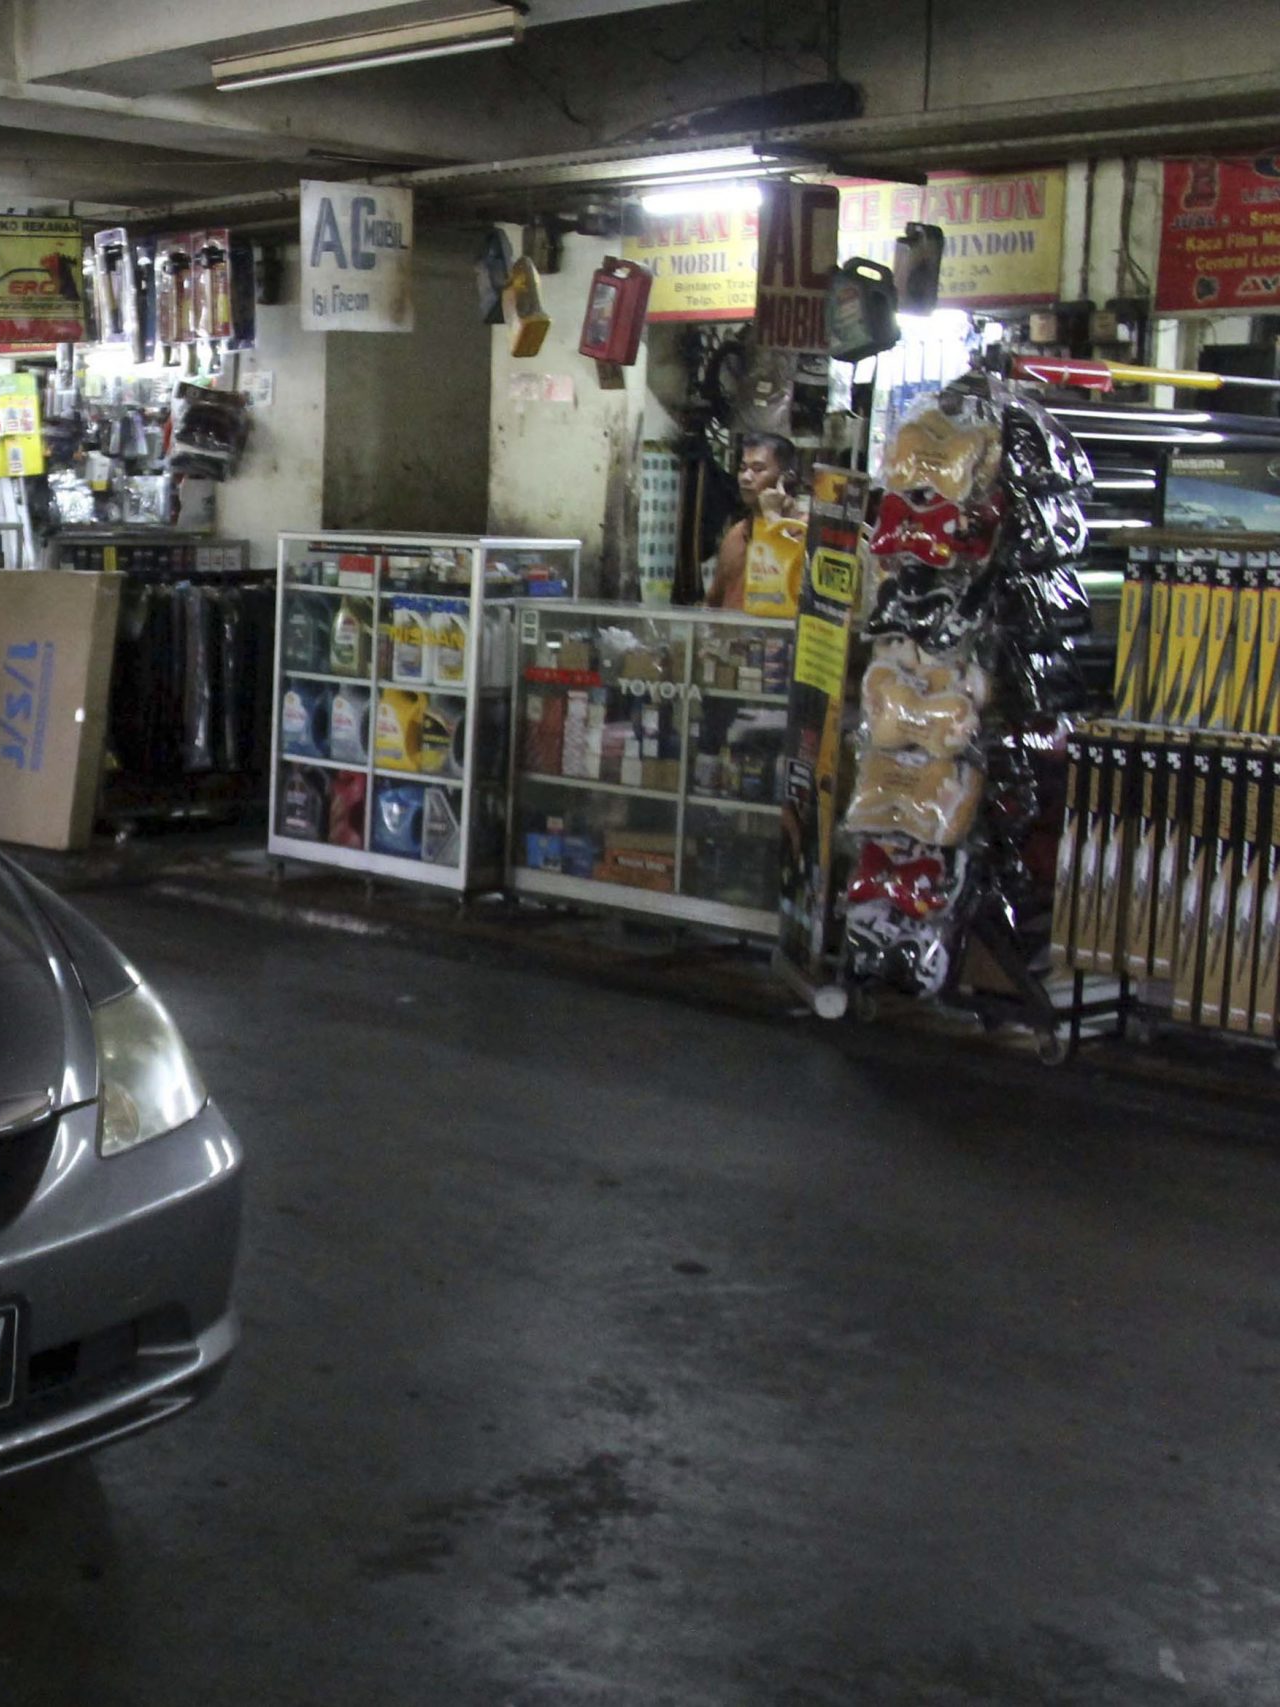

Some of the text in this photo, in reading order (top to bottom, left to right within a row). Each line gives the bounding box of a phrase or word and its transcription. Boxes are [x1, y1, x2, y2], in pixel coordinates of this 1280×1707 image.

[891, 176, 1047, 230] STATION
[311, 196, 376, 270] AC
[760, 184, 839, 289] AC
[670, 252, 728, 275] MOBIL
[674, 280, 722, 292] Bintaro
[618, 677, 703, 703] TOYOTA
